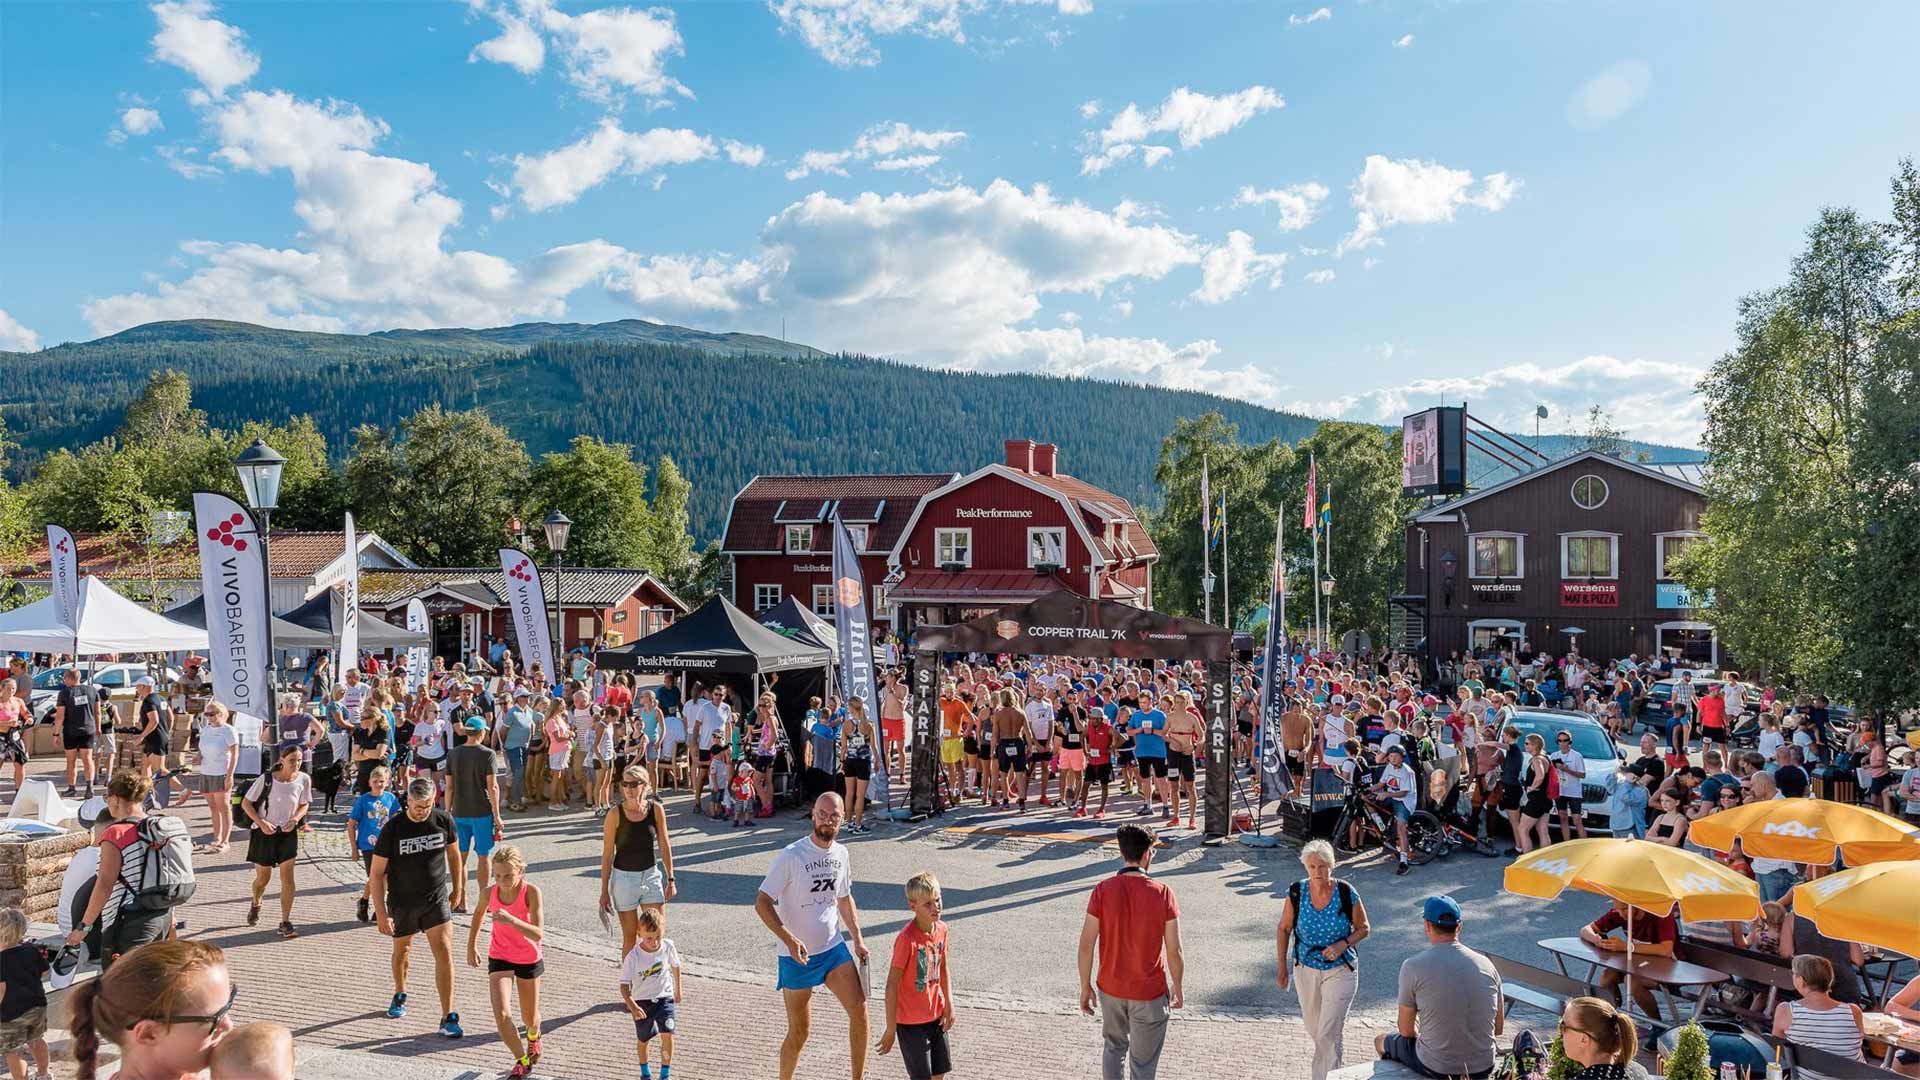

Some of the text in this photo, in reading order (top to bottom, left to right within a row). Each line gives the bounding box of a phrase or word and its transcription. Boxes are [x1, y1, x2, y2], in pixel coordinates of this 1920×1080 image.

[956, 507, 1033, 518] PeakPerformance
[1564, 593, 1579, 604] MAT
[1591, 593, 1616, 605] PIZZA
[221, 556, 250, 709] VIVOBAREFOOT
[518, 585, 542, 665] VIVOBAREFO
[1028, 626, 1127, 640] COPPER TRAIL 7K
[917, 669, 930, 745] START
[1211, 683, 1225, 764] START
[1762, 820, 1822, 839] MAX
